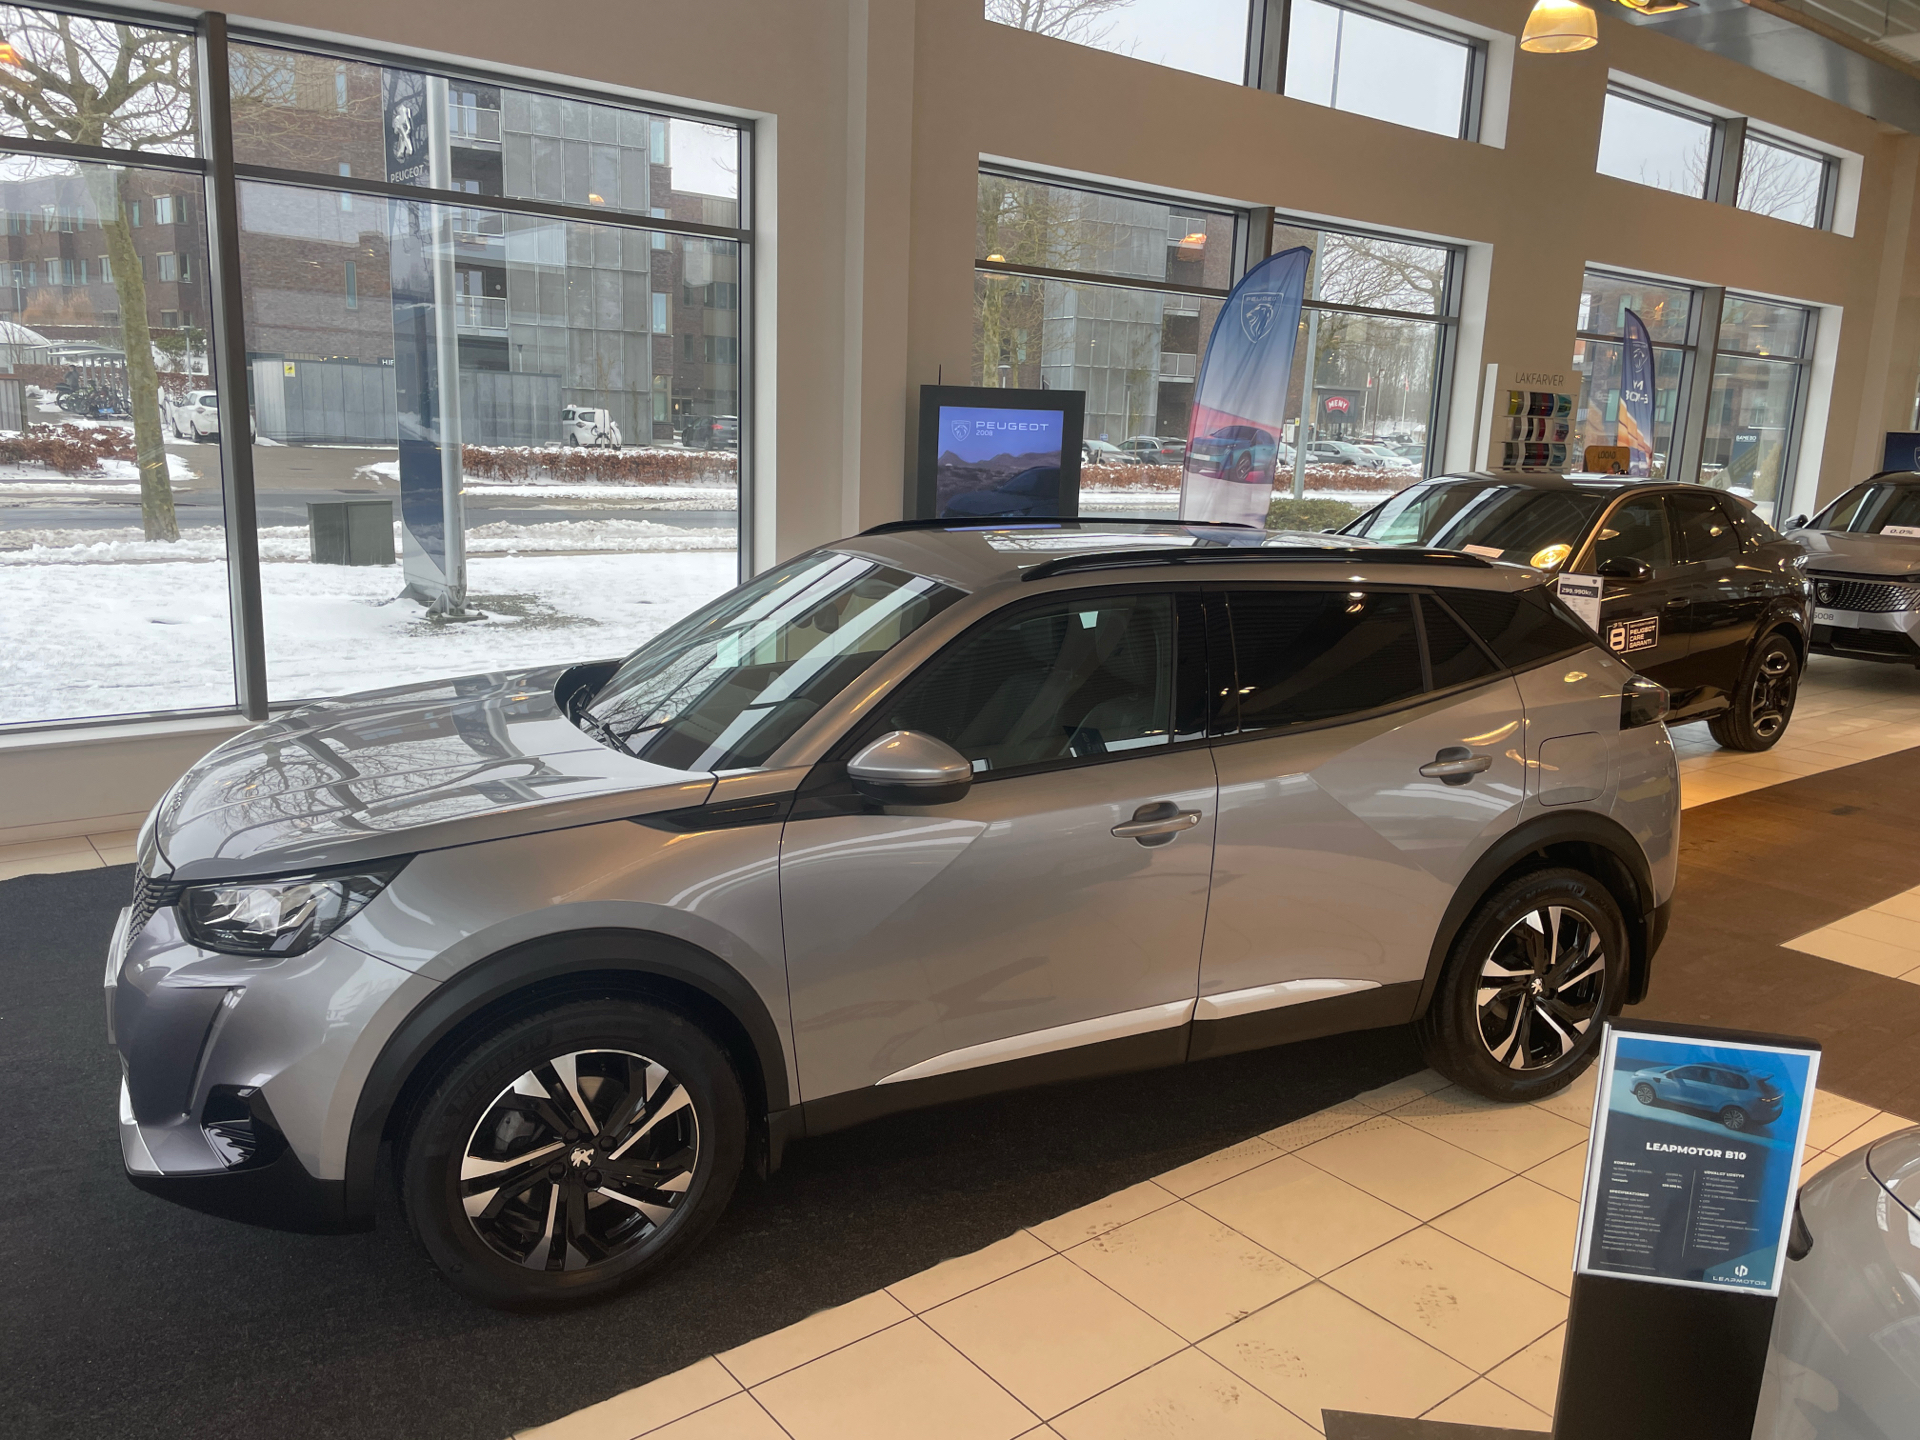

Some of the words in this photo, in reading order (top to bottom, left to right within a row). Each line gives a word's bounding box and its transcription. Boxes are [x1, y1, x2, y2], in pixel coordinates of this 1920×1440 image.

[390, 164, 424, 183] PEUGEOT
[1515, 372, 1564, 387] LAKFARVER
[1328, 399, 1348, 409] MENY
[976, 421, 1049, 431] PEUGEOT
[1630, 626, 1655, 635] PEUGEOT
[1610, 628, 1625, 650] 8
[1629, 634, 1645, 642] CARE
[1646, 1142, 1722, 1157] LEAPMOTOR
[1725, 1151, 1747, 1161] B10
[1712, 1275, 1767, 1286] LEAPMOTOR
